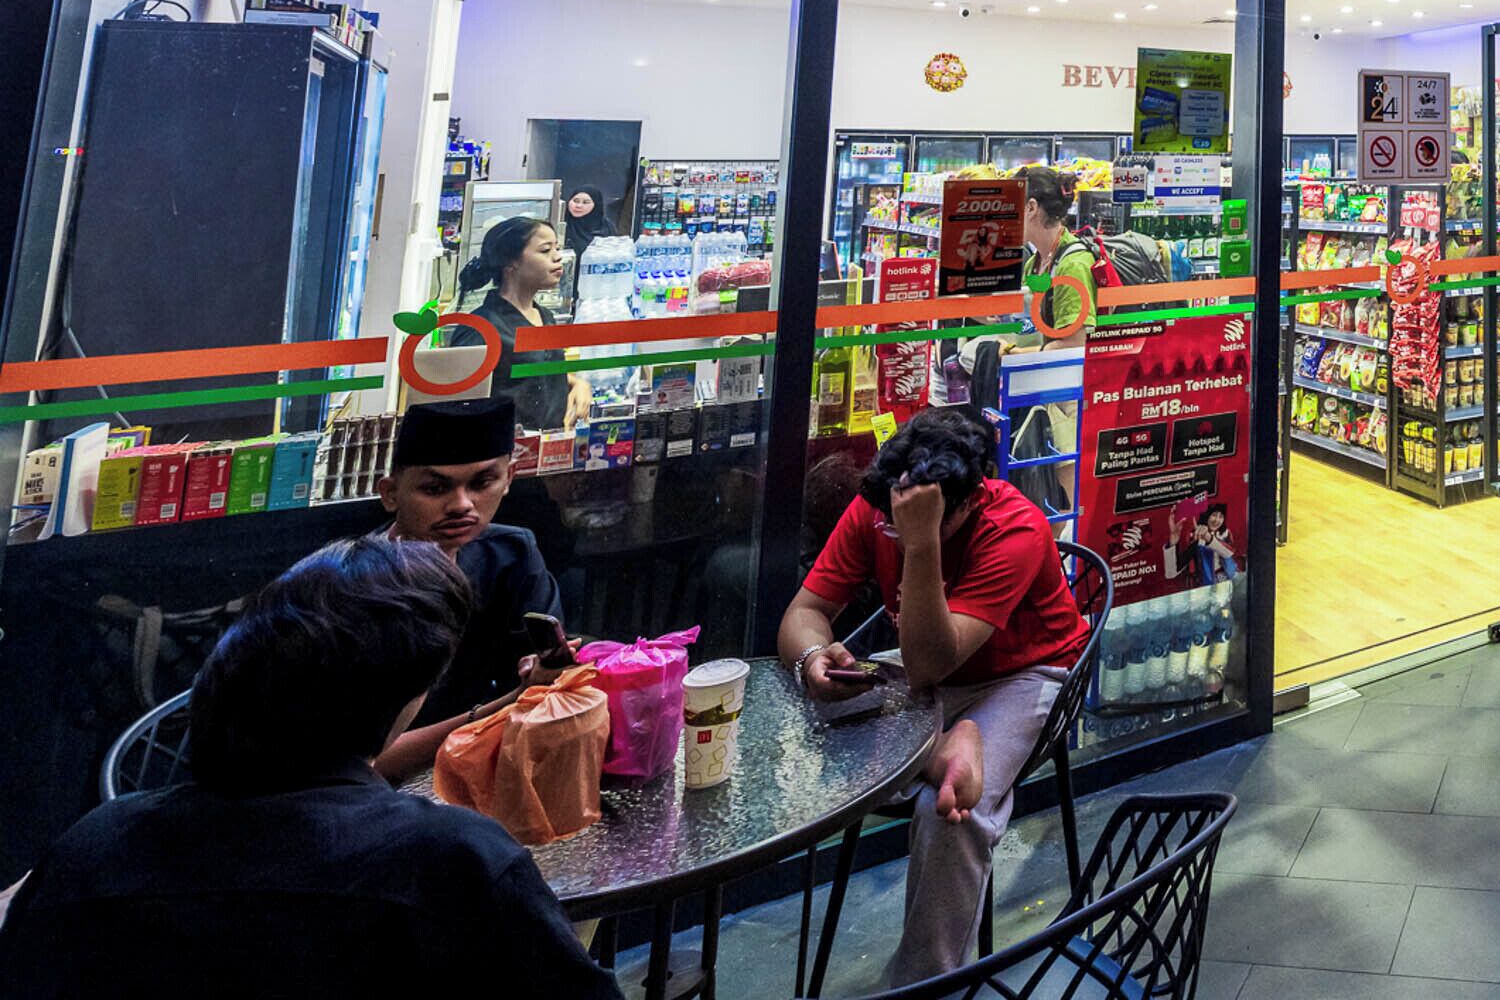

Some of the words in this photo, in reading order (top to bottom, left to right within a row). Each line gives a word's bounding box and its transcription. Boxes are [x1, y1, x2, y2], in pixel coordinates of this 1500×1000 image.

[1417, 80, 1437, 89] 24/7
[1371, 96, 1398, 119] 24
[1181, 187, 1204, 195] ACCEPT
[887, 267, 918, 276] hotlink
[1089, 329, 1121, 339] HOTLINK
[1121, 326, 1151, 336] PREPAID
[1089, 346, 1108, 354] EDISI
[1108, 343, 1134, 352] SABAH
[1220, 342, 1247, 352] hotlink
[1093, 391, 1120, 404] Pas
[1123, 383, 1182, 400] Bulanan
[1185, 374, 1243, 392] Terhebat
[1116, 436, 1128, 445] 4G
[1135, 433, 1148, 442] 5G
[1188, 435, 1220, 448] Hotspot
[1108, 449, 1135, 460] Tanpa
[1136, 445, 1154, 455] Had
[1183, 446, 1208, 457] Tanpa
[1208, 443, 1225, 453] Had
[1101, 458, 1129, 471] Paling
[1131, 454, 1160, 466] Pantas
[1138, 565, 1157, 575] NO.1
